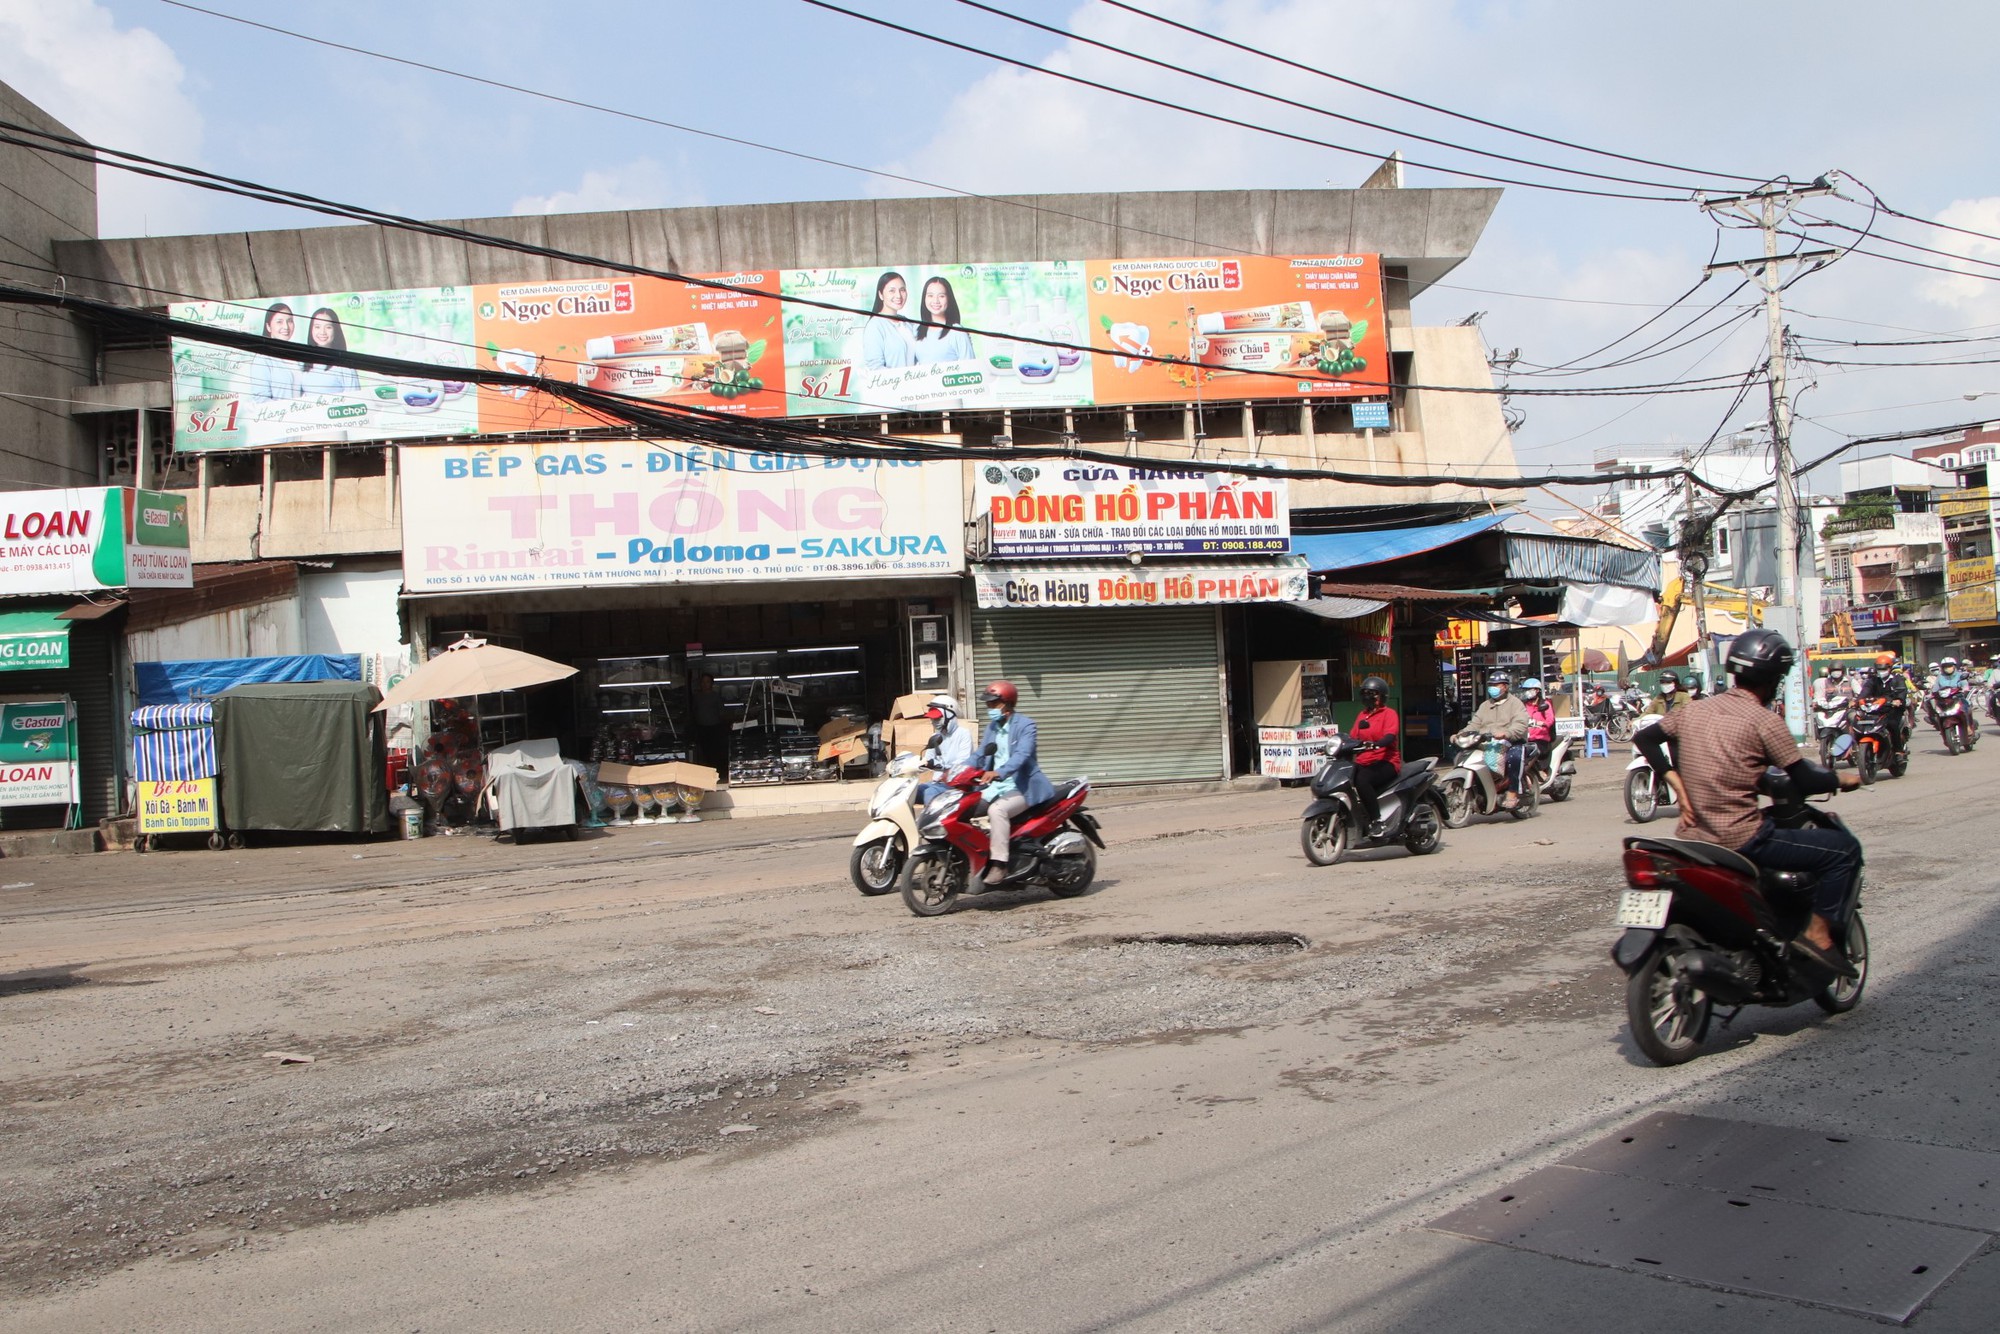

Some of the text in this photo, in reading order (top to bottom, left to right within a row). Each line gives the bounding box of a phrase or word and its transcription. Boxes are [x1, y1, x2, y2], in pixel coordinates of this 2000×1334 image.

[1113, 272, 1219, 296] Ngọc Châu
[501, 296, 611, 321] Ngọc Châu
[1214, 343, 1263, 357] Ngọc Châu
[603, 366, 653, 382] Ngọc Châu
[800, 366, 852, 398] Số 1
[943, 373, 981, 385] tin chọn
[901, 393, 914, 401] cho
[187, 400, 239, 433] Số 1
[329, 405, 367, 417] tin chọn
[286, 425, 299, 434] cho
[444, 448, 522, 479] BẾP
[536, 453, 607, 476] GAS
[646, 446, 736, 476] ĐIỆN
[750, 451, 810, 470] GIA
[1063, 465, 1120, 481] CỬA
[990, 481, 1276, 523] ĐỒNG HỒ PHẤN
[4, 510, 92, 540] LOAN
[150, 511, 169, 525] Castrol
[1020, 523, 1279, 539] MUA BÁN SỬA CHỮA TRAO ĐỔI CÁC LOẠI ĐỒNG HỒ MODEL ĐỜI MỚI
[9, 543, 91, 557] MÁY CÁC LOẠI
[424, 535, 948, 571] Rinnai Paloma SAKURA
[1053, 545, 1069, 553] TRUNG
[1070, 543, 1081, 552] TÂM
[1203, 541, 1219, 550] ĐT:
[1222, 540, 1283, 550] 0908.188.403
[26, 563, 71, 572] 0938.413.415
[132, 552, 188, 570] PHỤ TÙNG LOAN
[450, 574, 462, 584] SỐ
[489, 574, 508, 582] VĂN
[510, 573, 535, 581] NGÂN
[550, 572, 580, 580] TRUNG
[583, 571, 603, 579] TÂM
[606, 569, 641, 578] THƯƠNG
[644, 569, 661, 578] MẠI
[687, 566, 724, 575] TRƯỜNG
[727, 567, 744, 575] THỌ
[764, 564, 782, 573] THỦ
[785, 564, 803, 573] ĐỨC
[892, 561, 951, 570] 08.3896.8371
[1006, 578, 1039, 603] Cửa
[1045, 580, 1090, 603] Hàng
[1098, 575, 1157, 602] Đồng
[1164, 573, 1194, 599] Hồ
[1198, 572, 1279, 598] PHẤN
[18, 641, 63, 657] LOAN
[24, 716, 61, 728] Castrol
[1261, 731, 1312, 740] LONGINES OMEGA
[0, 767, 52, 782] LOAN
[1298, 760, 1312, 775] THAY
[146, 798, 208, 814] Xôi Gà Bánh Mì
[145, 818, 165, 828] Bánh
[181, 816, 210, 827] Topping
